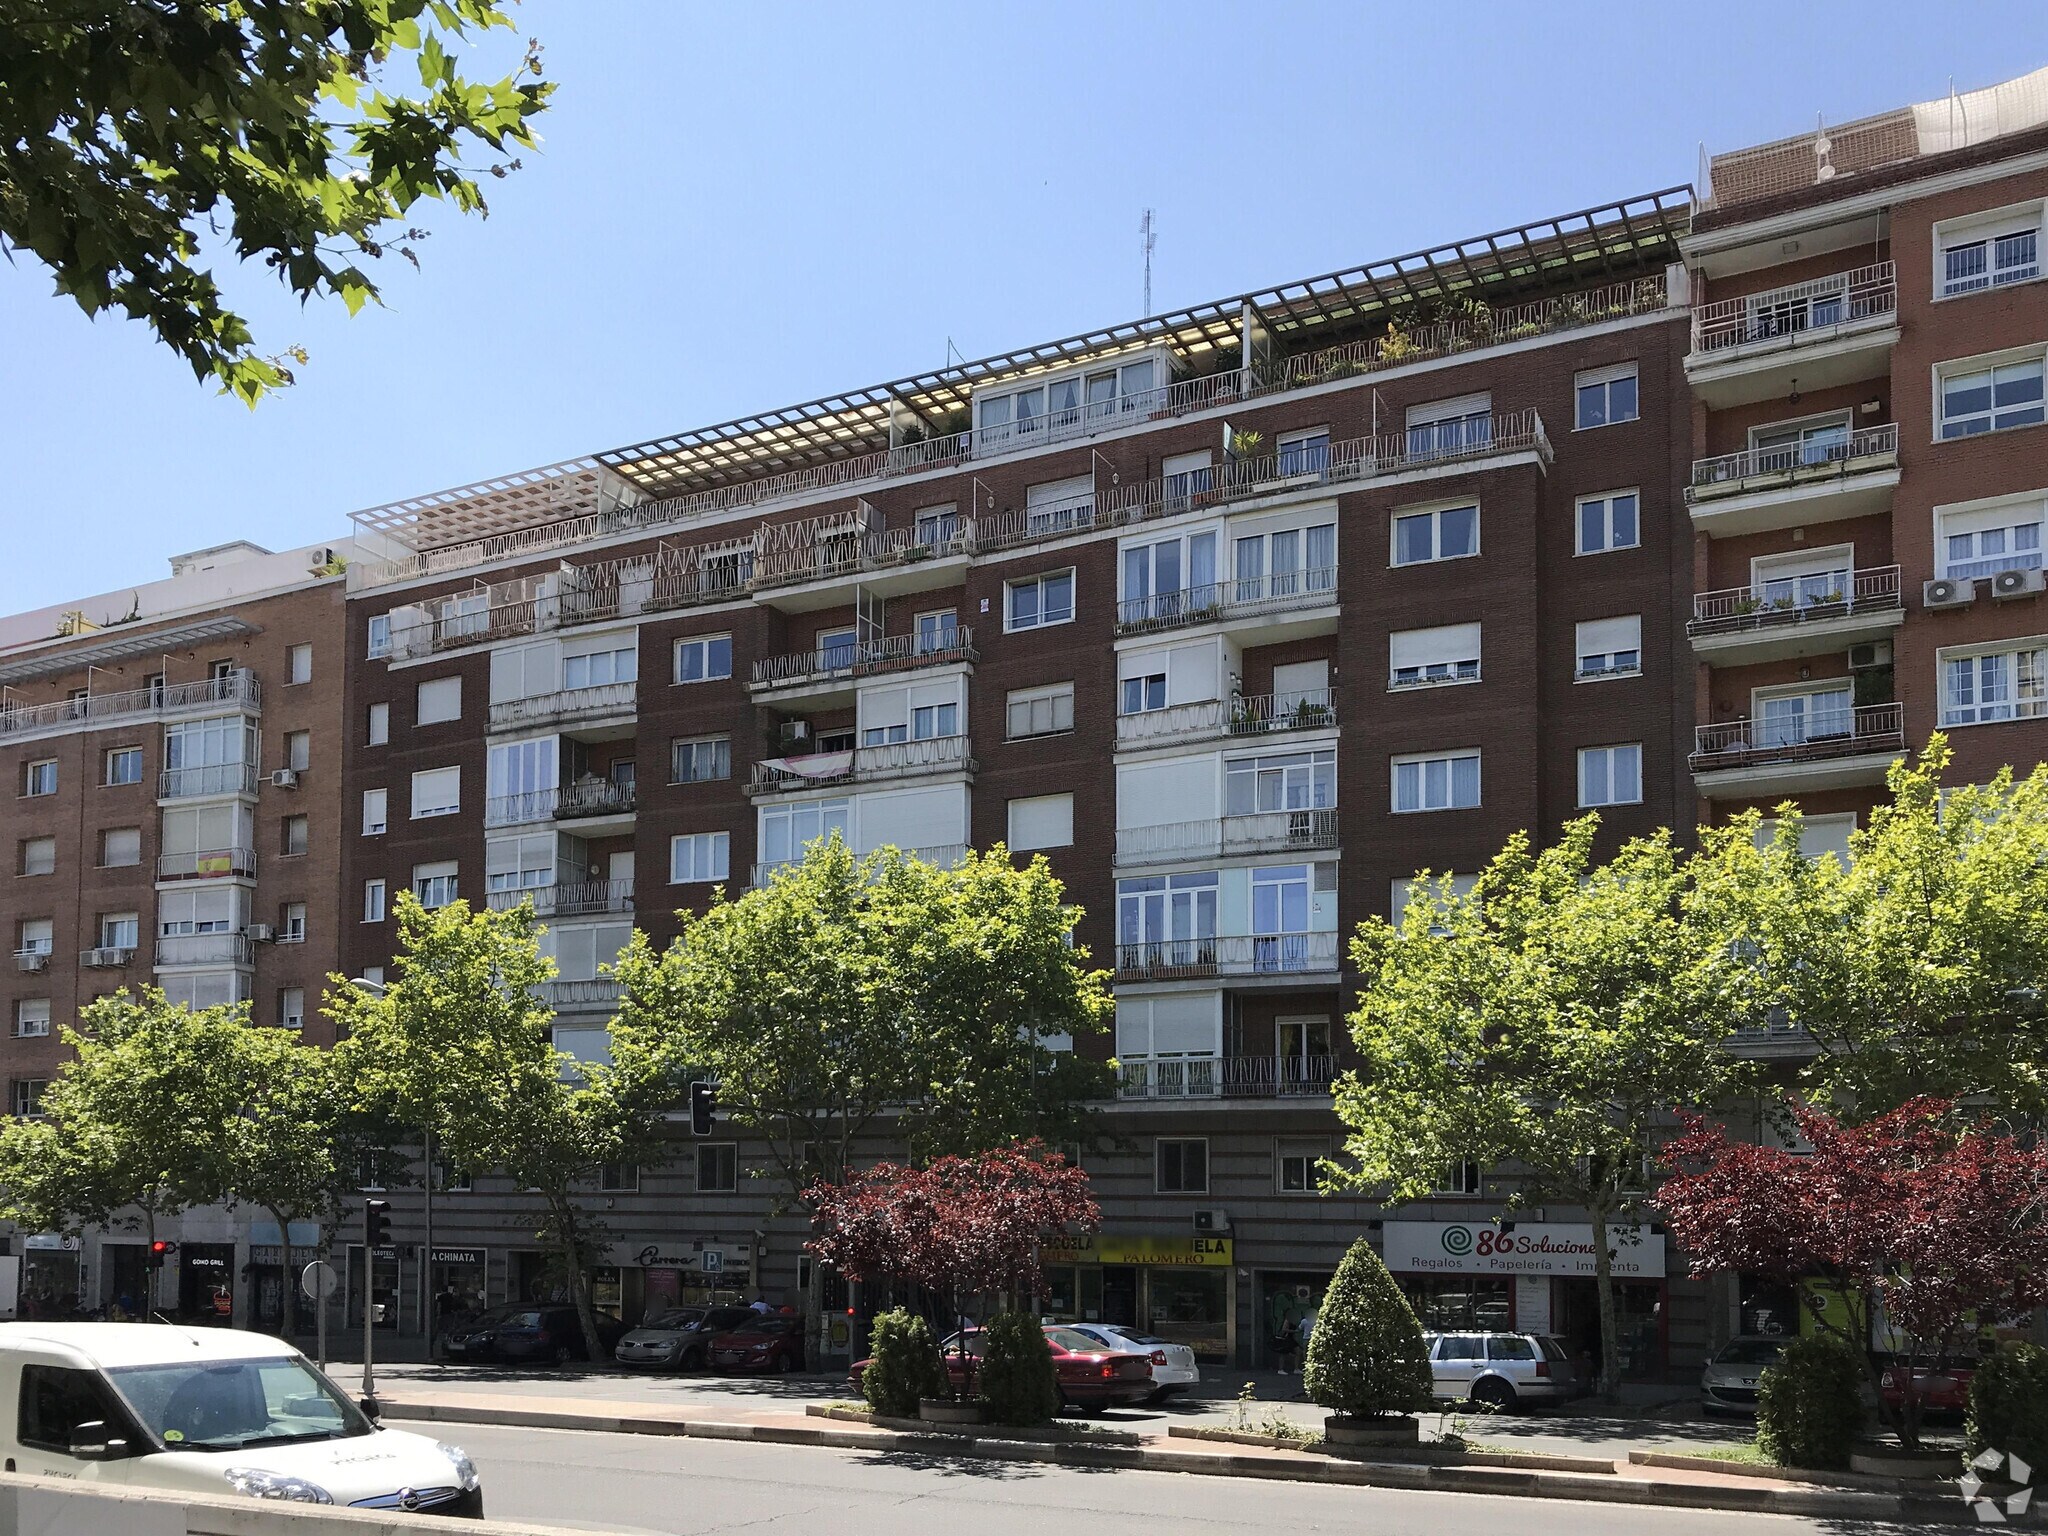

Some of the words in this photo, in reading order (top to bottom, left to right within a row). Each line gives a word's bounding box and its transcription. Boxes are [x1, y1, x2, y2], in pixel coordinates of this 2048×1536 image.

[1476, 1230, 1514, 1257] 86
[1516, 1235, 1596, 1255] Solucione
[438, 1252, 476, 1263] CHINATA
[632, 1245, 697, 1266] Carrera
[707, 1253, 717, 1270] P
[1123, 1253, 1205, 1264] PALOMERO
[1411, 1256, 1463, 1270] Regalos
[1490, 1258, 1552, 1271] Papelería
[1576, 1261, 1640, 1273] Imenta
